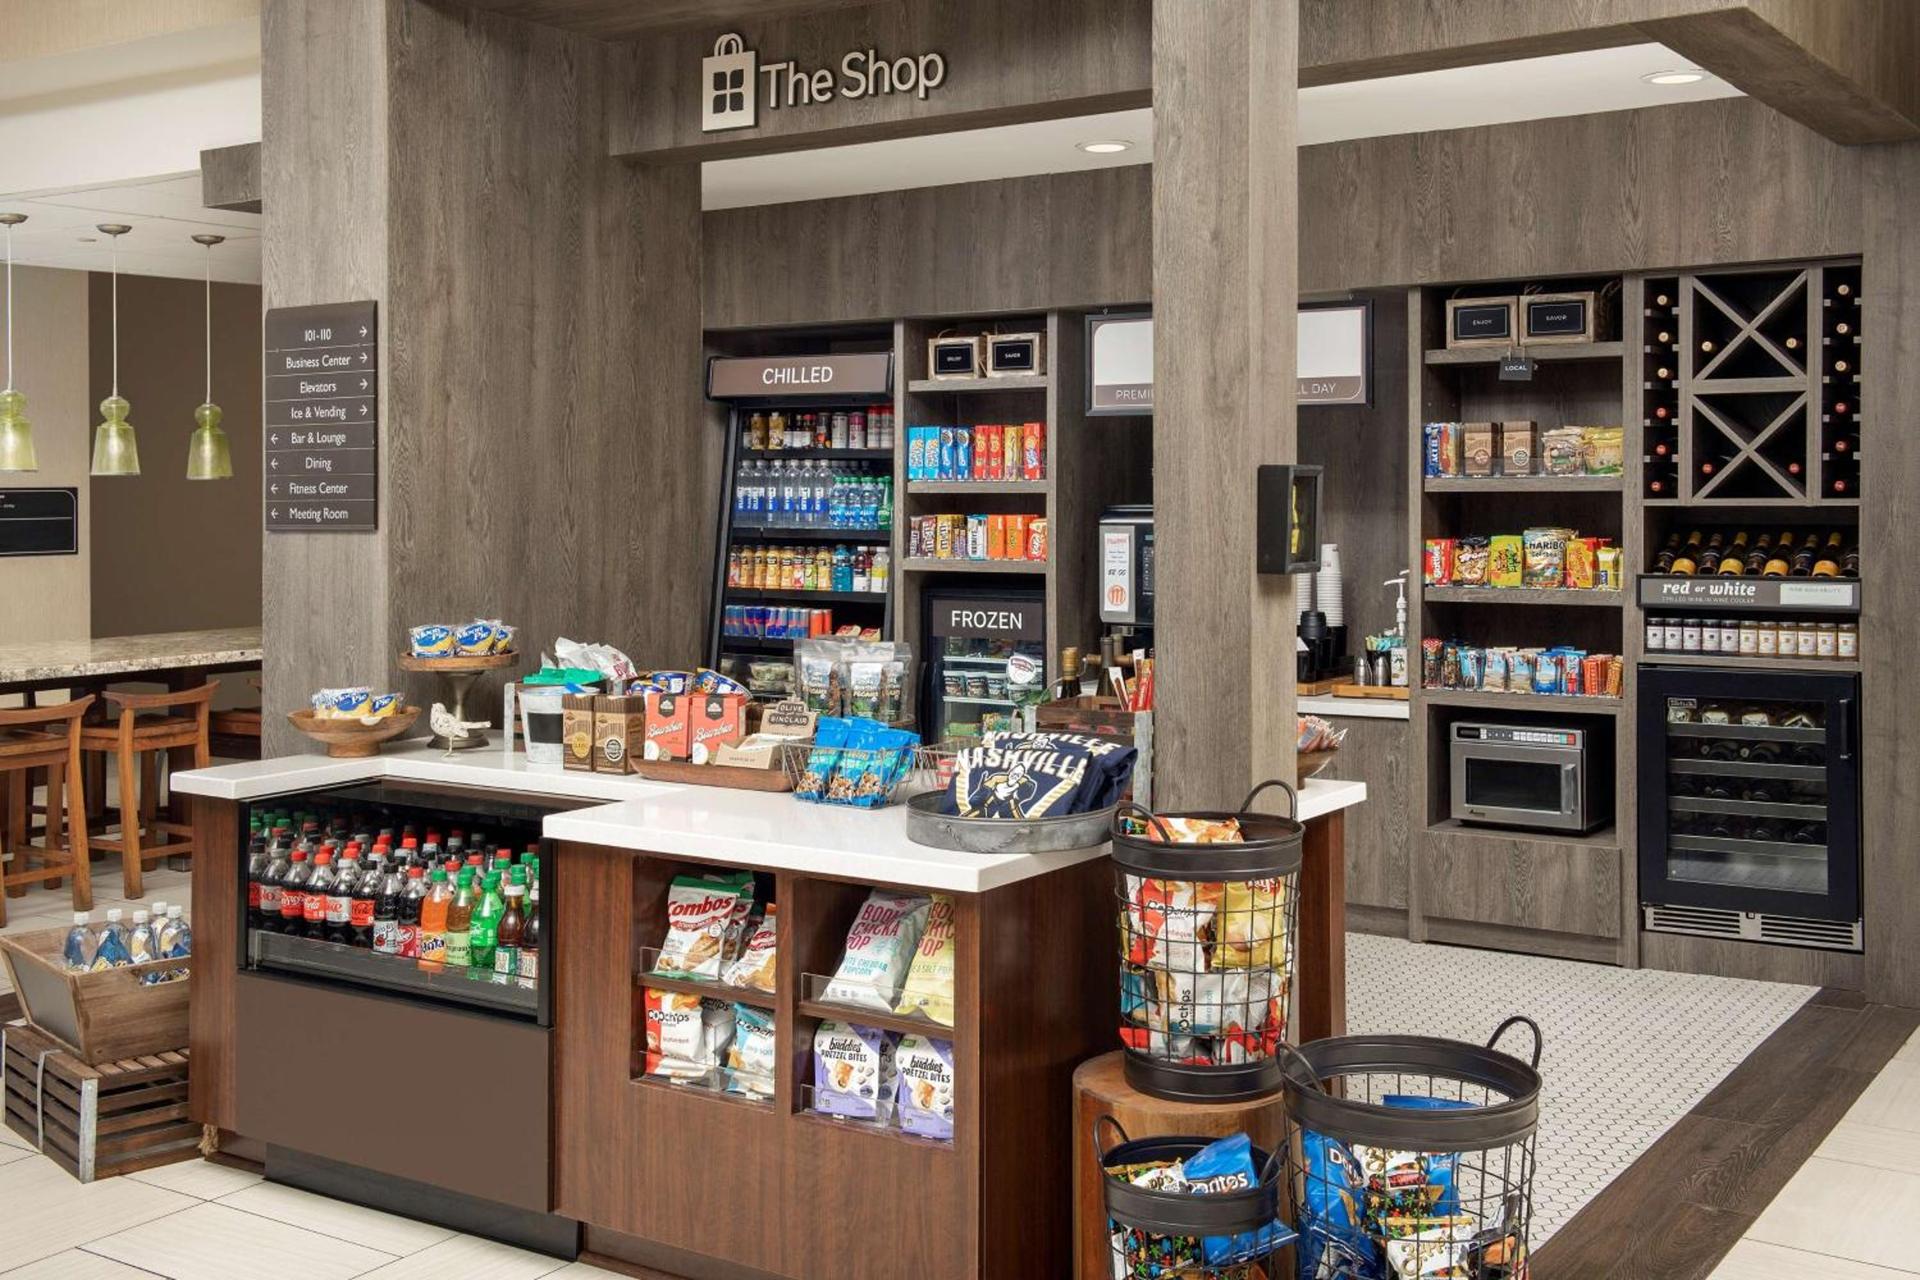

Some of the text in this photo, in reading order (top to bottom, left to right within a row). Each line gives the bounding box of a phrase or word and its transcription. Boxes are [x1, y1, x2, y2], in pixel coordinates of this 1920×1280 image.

[760, 50, 944, 108] The Shop
[304, 328, 332, 341] 101-110
[286, 354, 351, 370] Business Center
[1505, 364, 1527, 372] LOCAL
[762, 366, 833, 384] CHILLED
[300, 381, 337, 393] Elevators
[1312, 383, 1336, 394] DAY
[291, 406, 346, 420] Ice & Vending
[291, 432, 346, 446] Bar & Lounge
[306, 457, 332, 472] Dining
[290, 482, 348, 494] Fitness Center
[290, 508, 348, 522] Meeting Room
[1662, 582, 1690, 594] red
[1709, 582, 1756, 596] white
[951, 610, 1022, 629] FROZEN
[422, 938, 445, 953] anta
[829, 1037, 862, 1052] buddies
[821, 1050, 868, 1062] PRETZEL BITES
[910, 1055, 944, 1073] buddies
[902, 1067, 951, 1083] PRETZEL BITES
